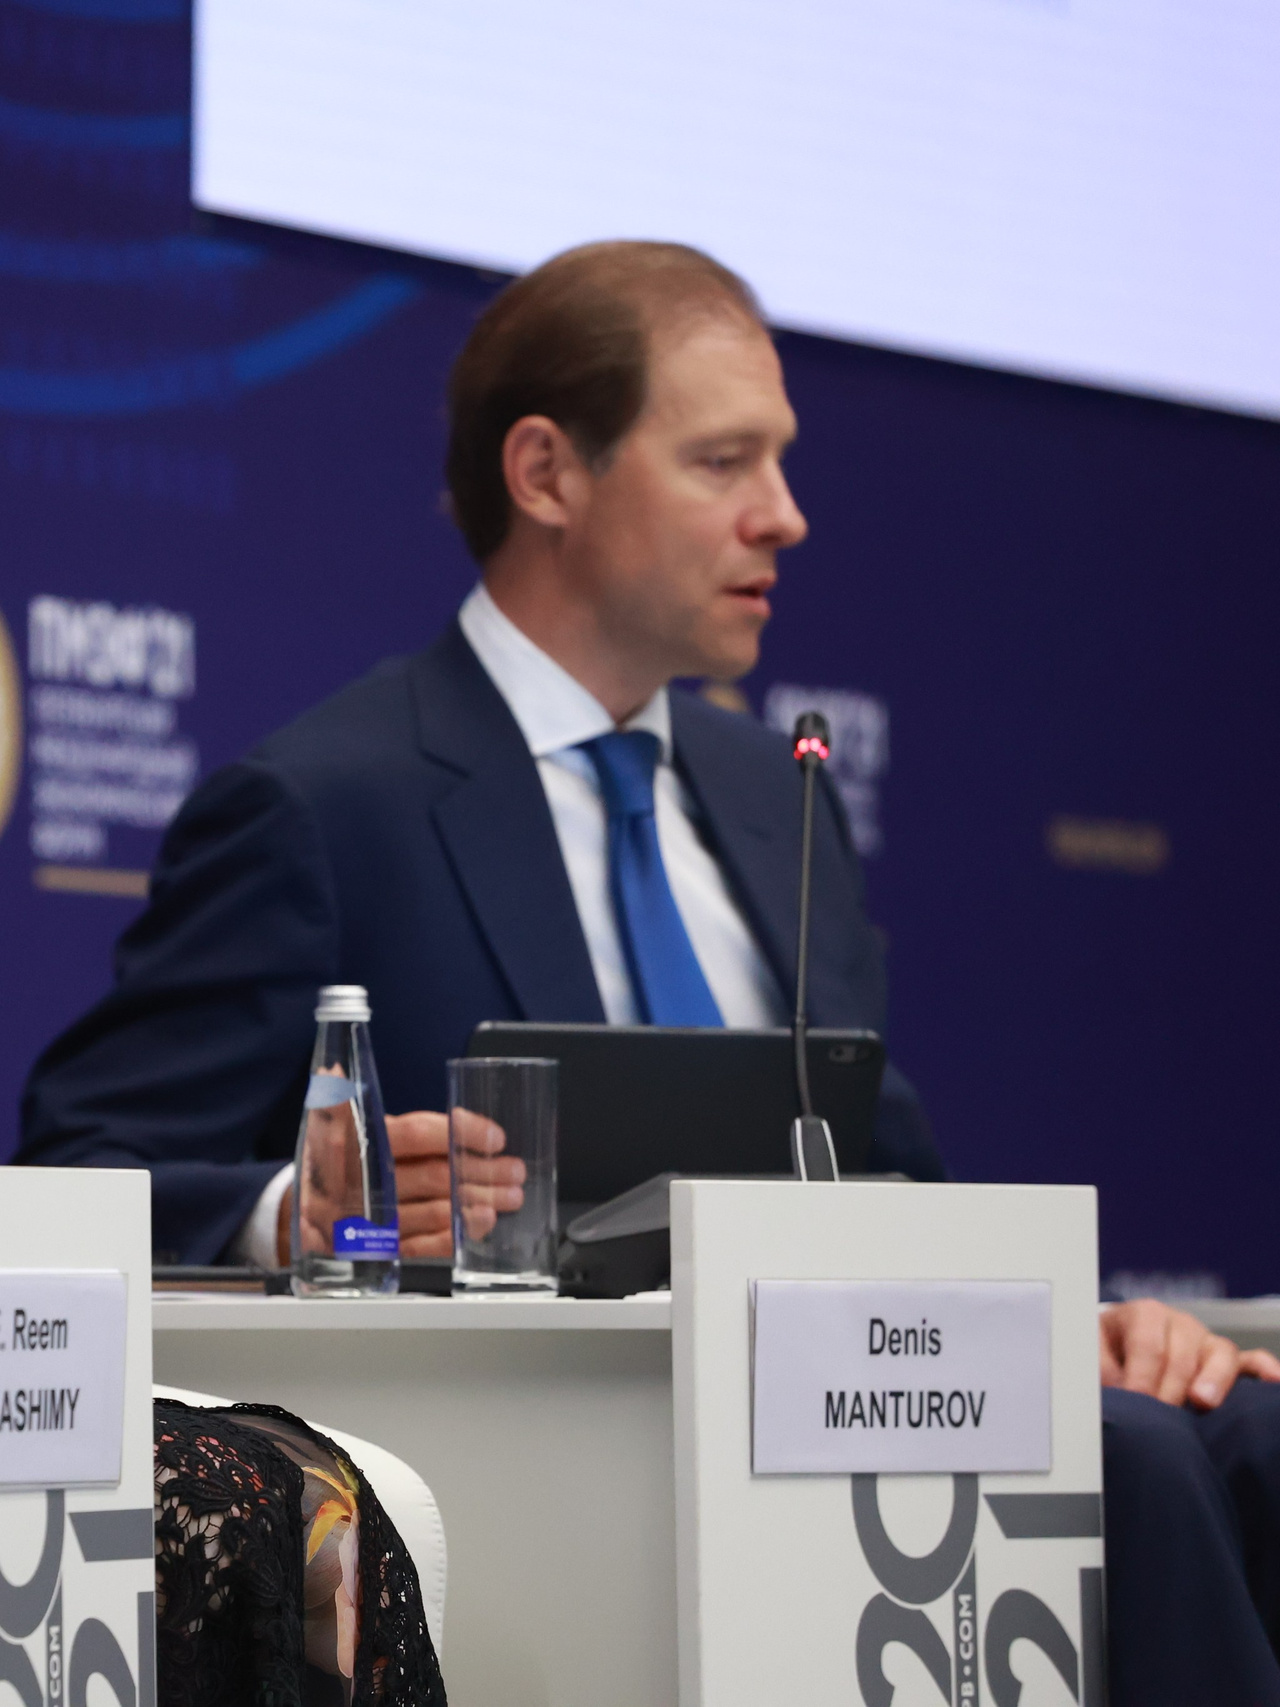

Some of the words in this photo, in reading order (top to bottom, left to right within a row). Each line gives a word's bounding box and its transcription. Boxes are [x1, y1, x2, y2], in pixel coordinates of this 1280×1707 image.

[13, 1309, 69, 1351] Reem
[868, 1317, 943, 1356] Denis
[824, 1390, 987, 1429] MANTUROV
